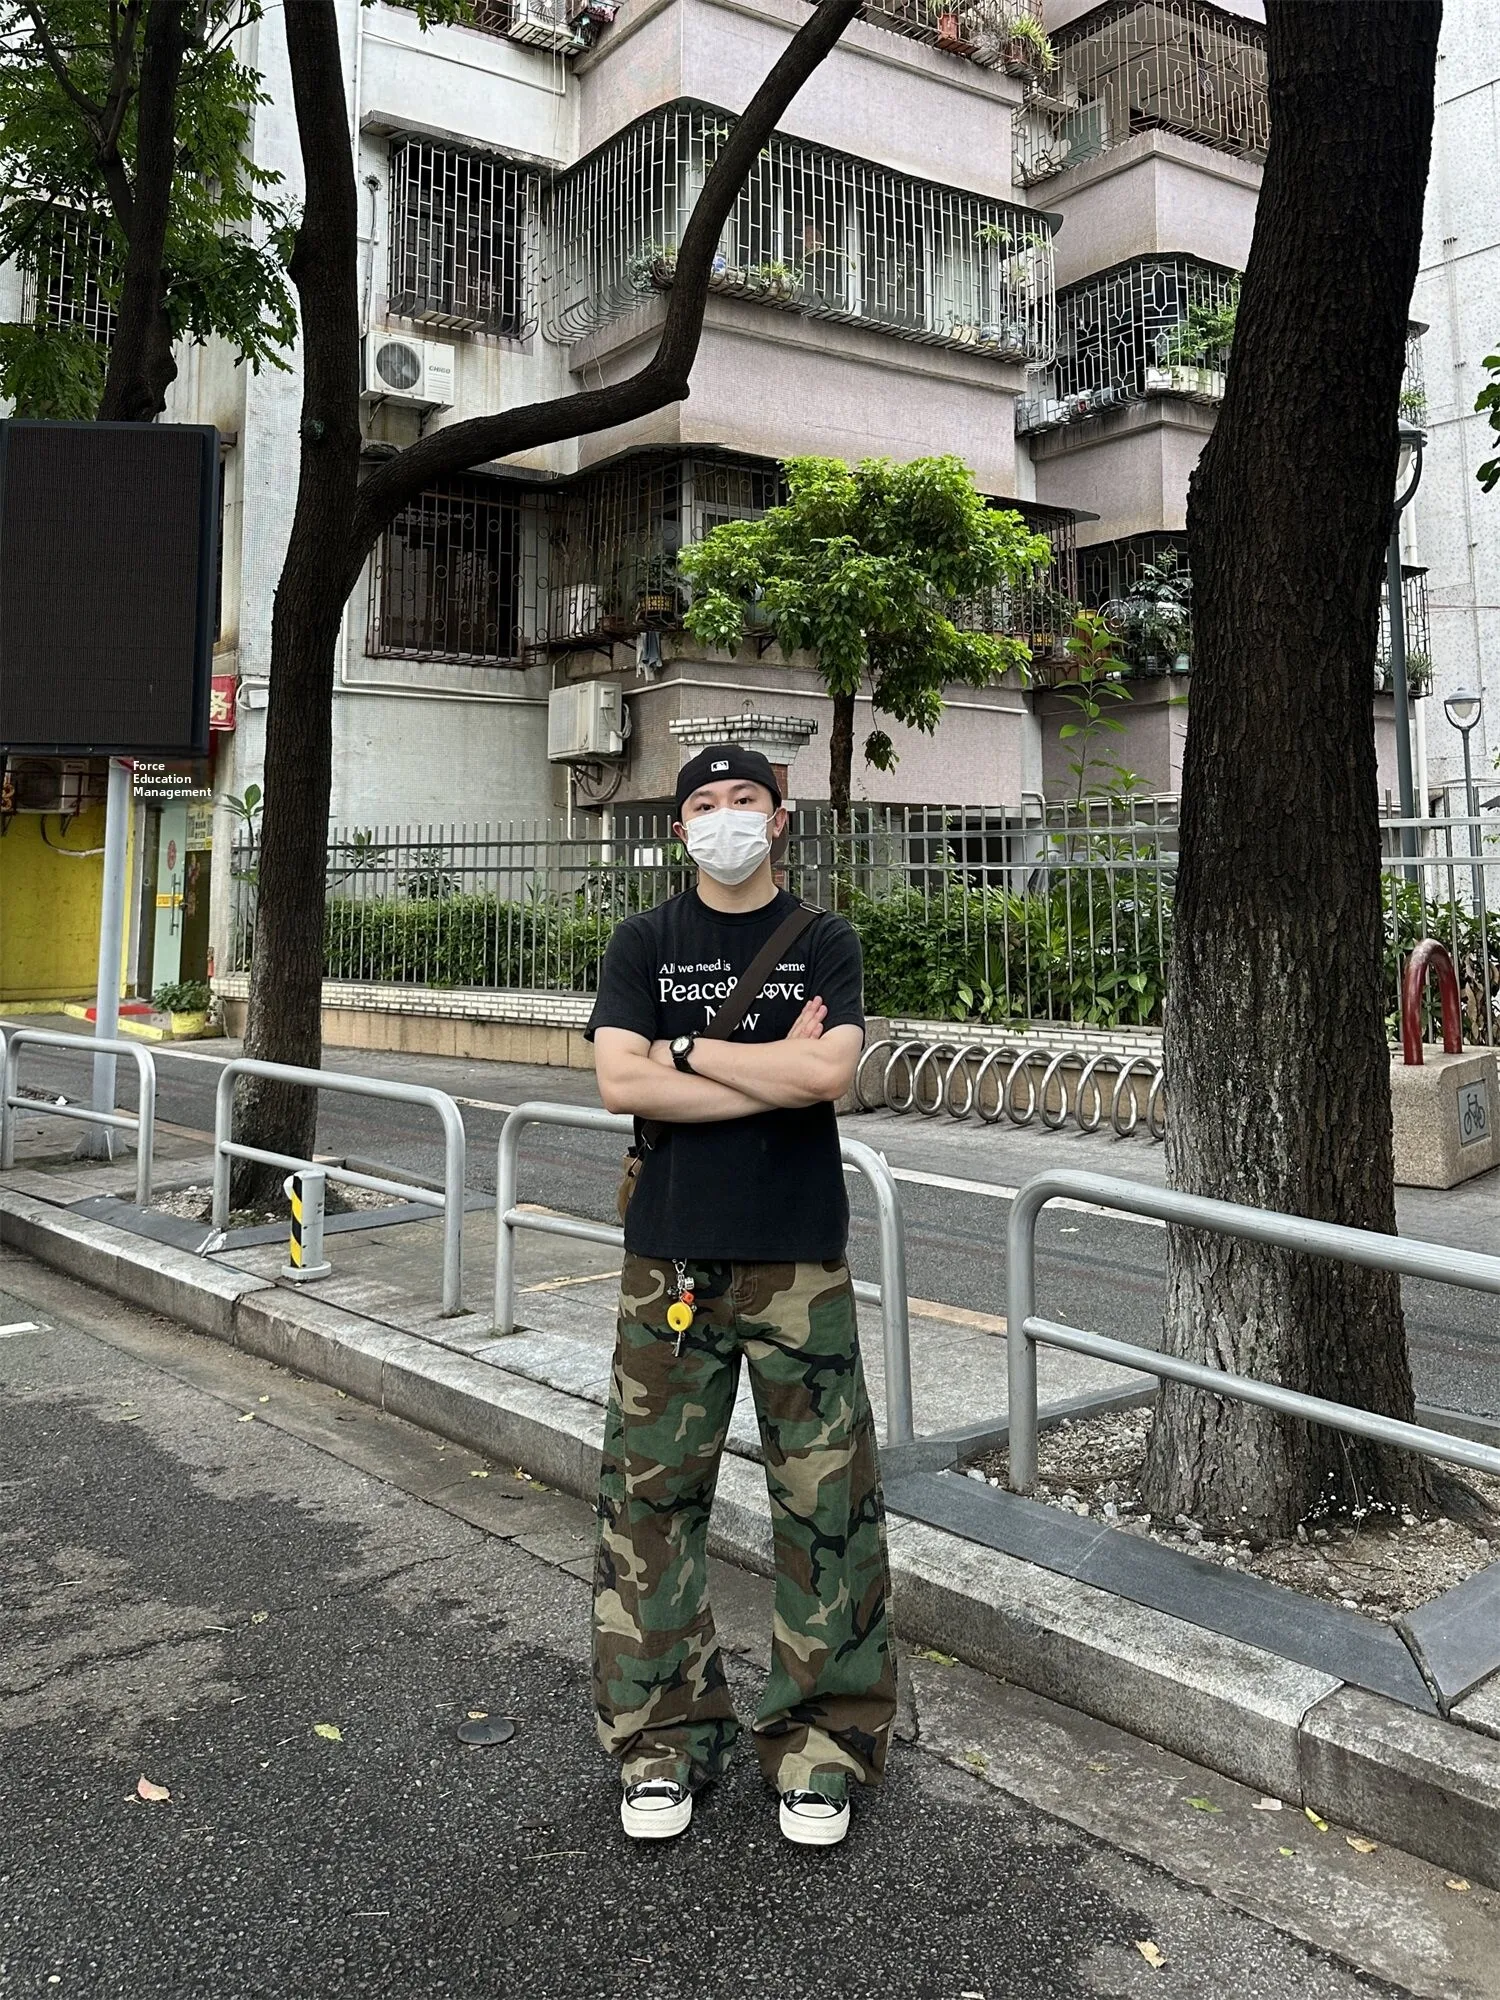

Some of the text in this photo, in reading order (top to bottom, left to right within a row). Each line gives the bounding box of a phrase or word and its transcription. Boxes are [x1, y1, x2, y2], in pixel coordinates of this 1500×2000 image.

[677, 964, 694, 973] we
[695, 958, 722, 972] need
[723, 959, 732, 972] is
[704, 1005, 760, 1031] Nw
